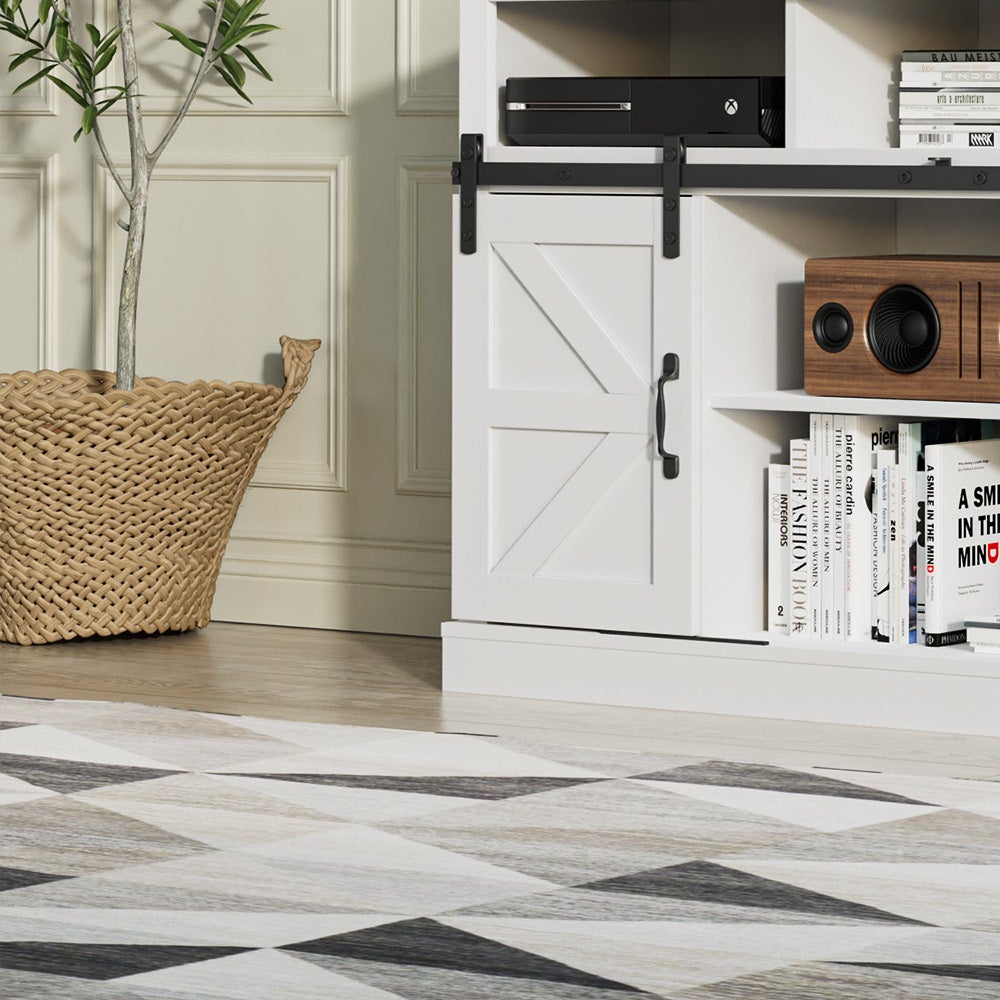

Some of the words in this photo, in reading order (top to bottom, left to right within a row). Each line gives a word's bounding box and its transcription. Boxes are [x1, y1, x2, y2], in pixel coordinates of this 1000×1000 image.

[931, 53, 958, 63] BAU
[970, 133, 993, 146] MARK
[792, 443, 807, 484] THE
[845, 434, 855, 472] pierre
[835, 494, 842, 508] OF
[845, 475, 855, 516] cardin
[927, 475, 935, 507] SMILE
[958, 488, 969, 510] A
[780, 493, 789, 547] INTERIORS
[927, 509, 935, 521] IN
[792, 489, 808, 573] FASHION
[927, 523, 935, 543] THE
[958, 516, 973, 539] IN
[812, 536, 819, 549] OF
[824, 536, 830, 549] OF
[927, 545, 935, 574] MIND
[958, 542, 999, 568] MIND
[777, 605, 784, 617] 2
[792, 579, 808, 634] BOOK
